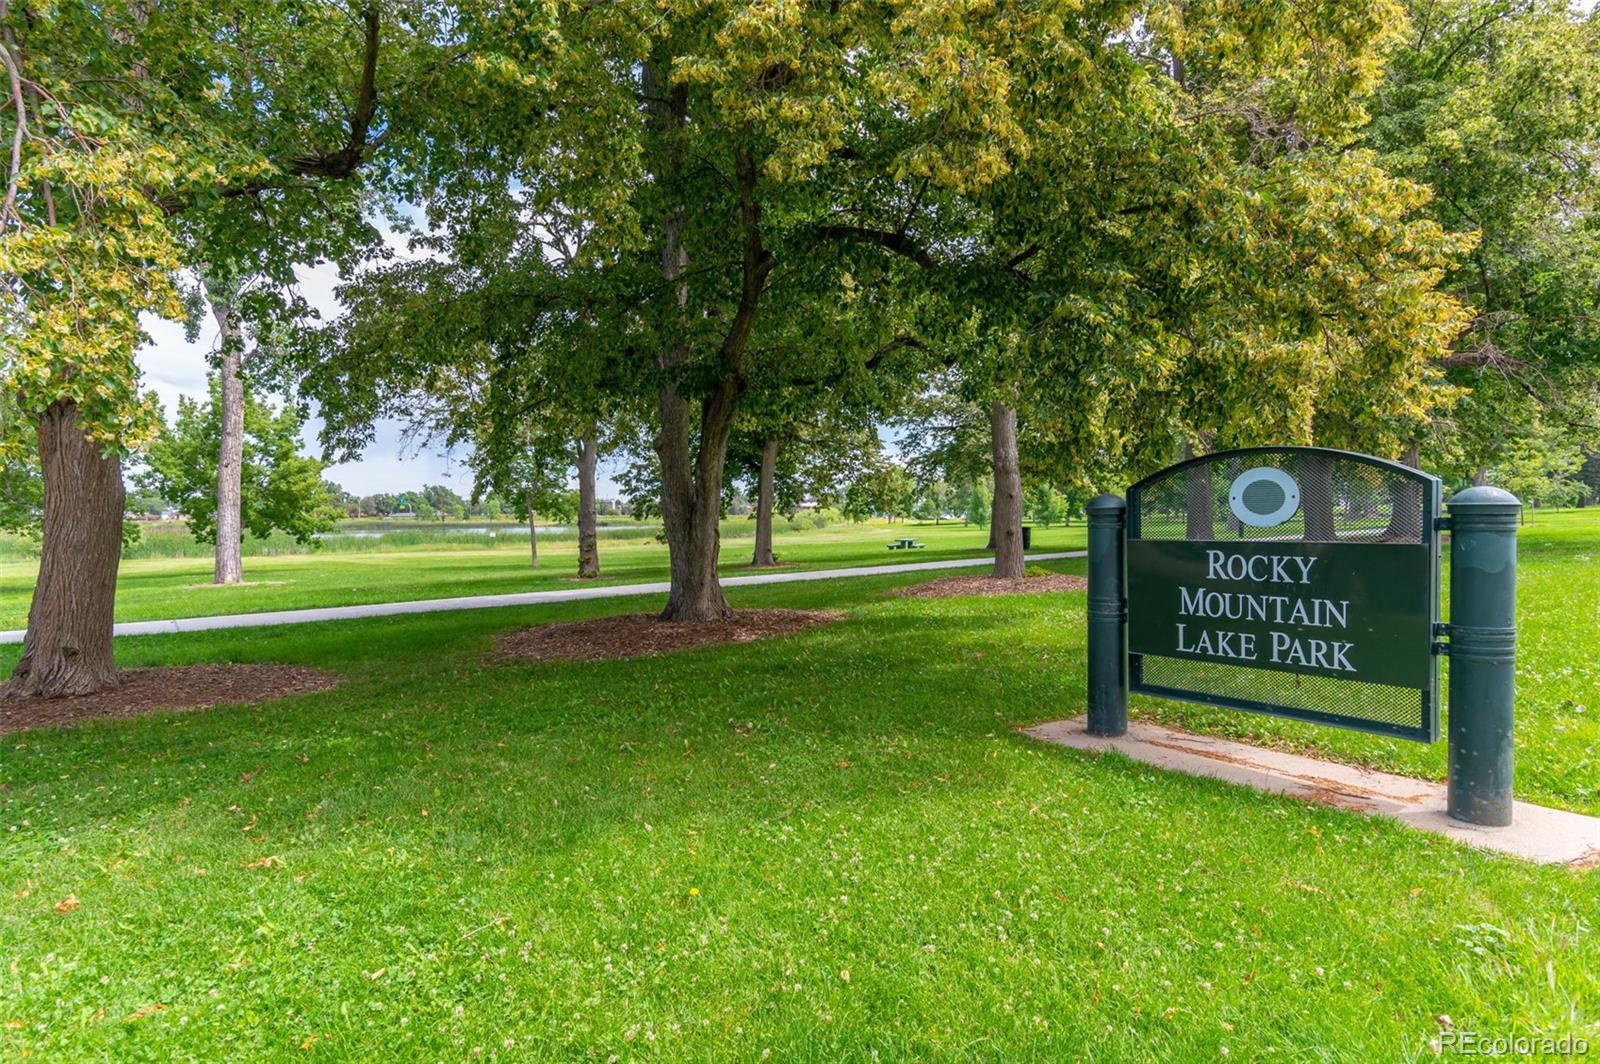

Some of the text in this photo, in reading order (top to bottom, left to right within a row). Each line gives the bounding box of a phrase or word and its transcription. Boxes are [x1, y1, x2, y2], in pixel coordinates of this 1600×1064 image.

[1206, 549, 1318, 584] ROCKY
[1178, 586, 1350, 629] MOUNTAIN
[1175, 622, 1357, 672] LAKE PARK
